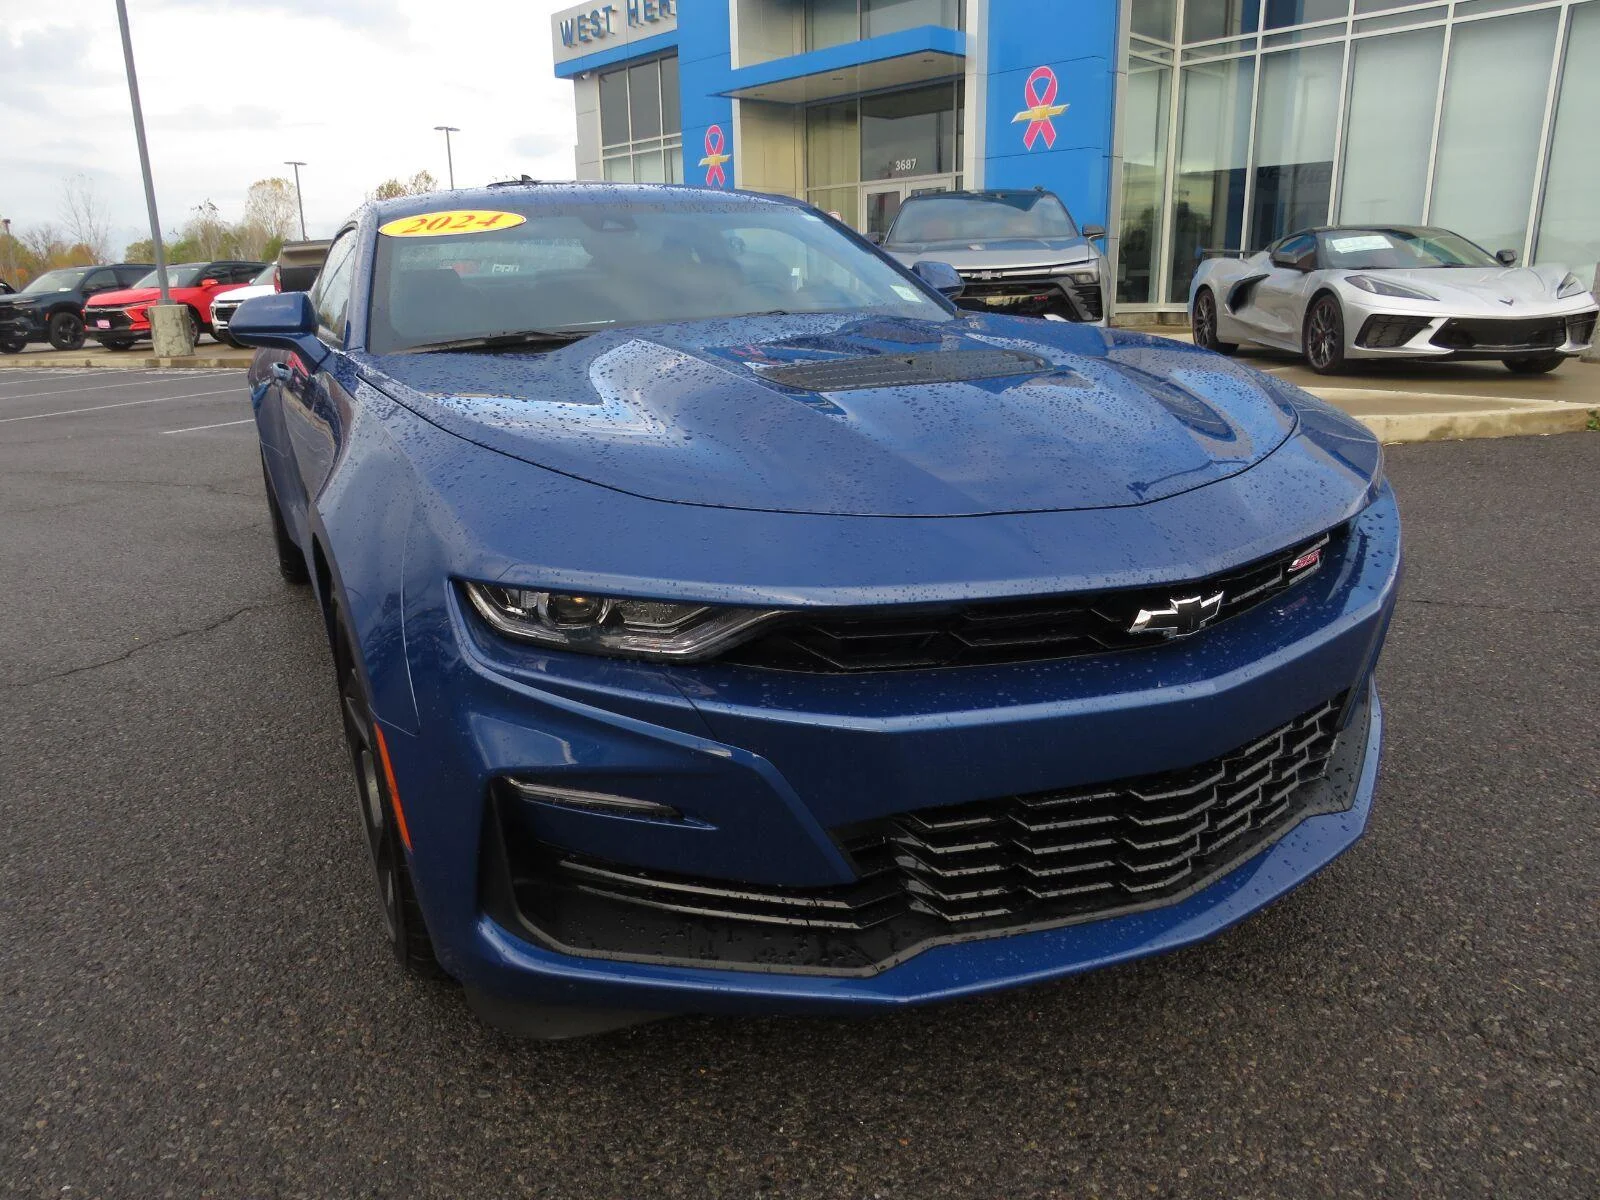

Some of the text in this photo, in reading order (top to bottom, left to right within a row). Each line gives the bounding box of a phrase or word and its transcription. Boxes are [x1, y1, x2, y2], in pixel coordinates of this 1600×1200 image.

[560, 5, 615, 47] WEST
[895, 158, 917, 171] 3687
[402, 214, 504, 233] 2024
